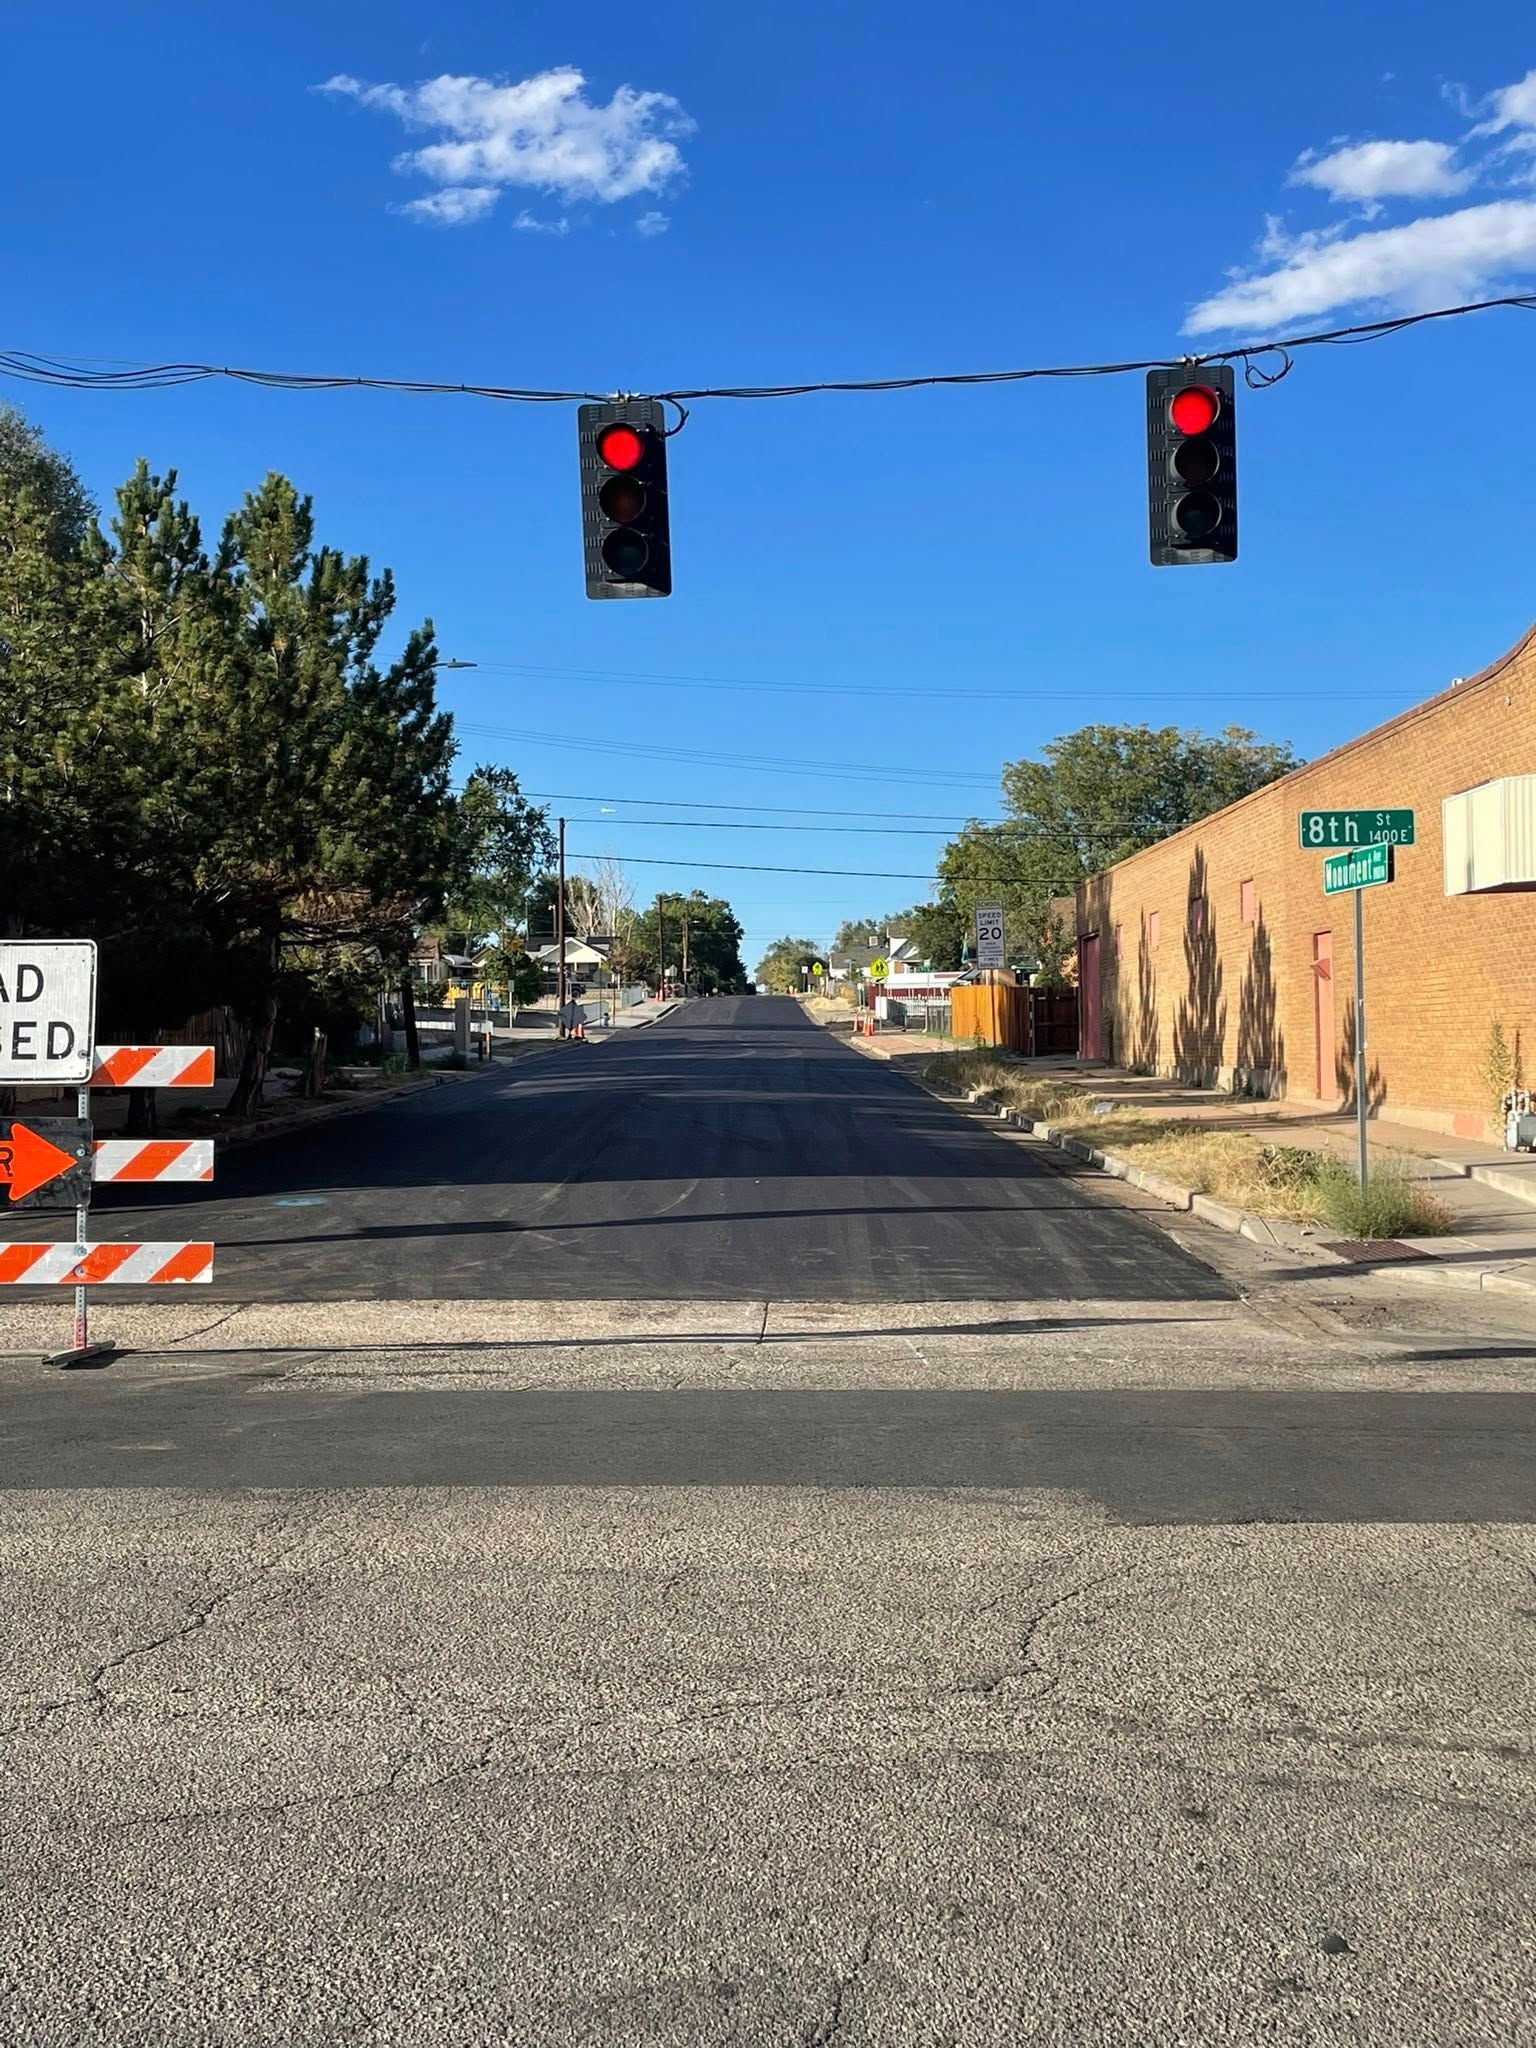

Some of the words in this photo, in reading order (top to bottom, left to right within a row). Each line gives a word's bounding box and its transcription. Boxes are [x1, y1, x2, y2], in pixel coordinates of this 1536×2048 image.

[1309, 815, 1359, 843] 8th
[1376, 813, 1391, 826] St
[1369, 830, 1398, 843] 1400
[1326, 854, 1372, 889] Monument
[979, 927, 1002, 941] 20
[0, 1021, 75, 1060] ED
